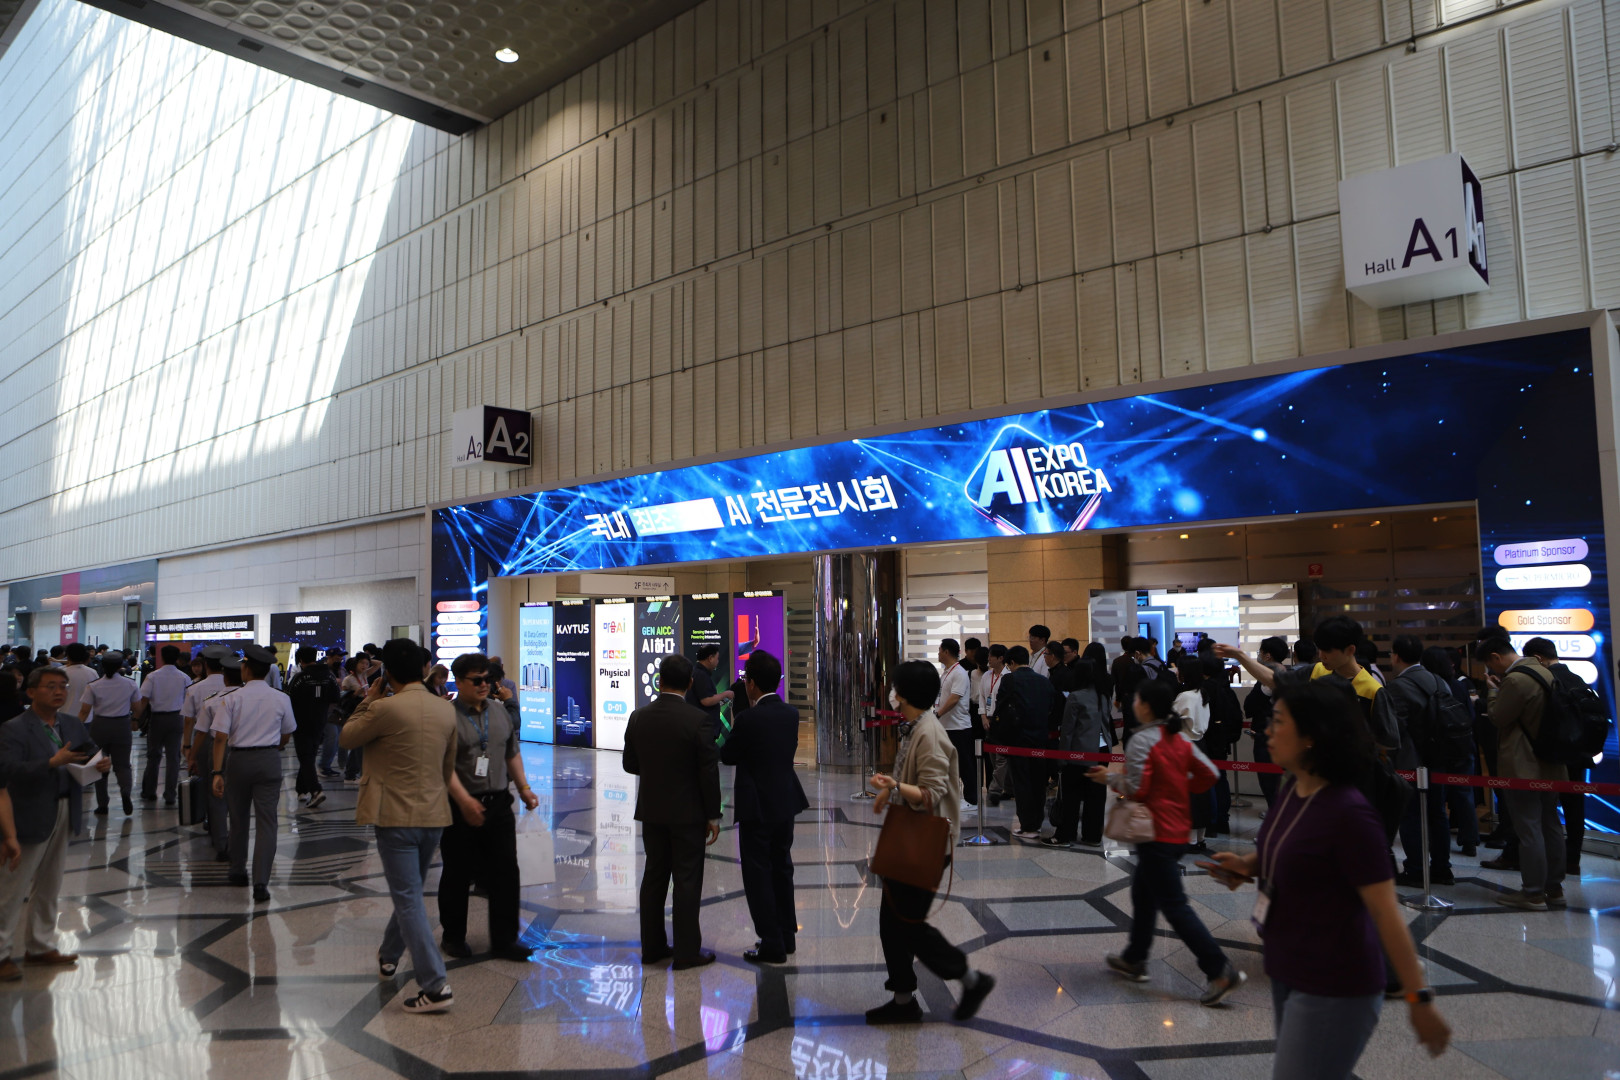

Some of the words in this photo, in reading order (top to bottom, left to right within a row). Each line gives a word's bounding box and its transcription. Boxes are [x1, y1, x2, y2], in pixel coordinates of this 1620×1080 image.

[1364, 258, 1397, 276] Hall
[1401, 217, 1459, 269] A1
[486, 416, 529, 458] A2
[456, 454, 466, 463] Hall
[466, 435, 483, 461] A2
[1027, 442, 1088, 473] EXPO
[977, 447, 1039, 508] AI
[1035, 468, 1113, 499] KOREA
[585, 510, 632, 541] 국내
[725, 494, 752, 527] AI
[755, 475, 899, 524] 전문전시회
[1504, 548, 1540, 560] Platinum
[1541, 545, 1576, 558] Sponsor
[294, 615, 320, 624] INFORMATION
[1517, 615, 1535, 626] Gold
[1536, 614, 1573, 626] Sponsor
[556, 623, 590, 635] KAYTUS
[641, 626, 656, 636] GEN
[1513, 639, 1581, 653] KUS
[600, 668, 630, 678] Physical
[610, 680, 620, 689] AI
[1232, 762, 1250, 770] coex
[1399, 771, 1415, 781] oex
[1447, 775, 1470, 784] coex
[1487, 778, 1511, 787] coex
[1529, 780, 1553, 790] coex
[1573, 783, 1598, 793] coex
